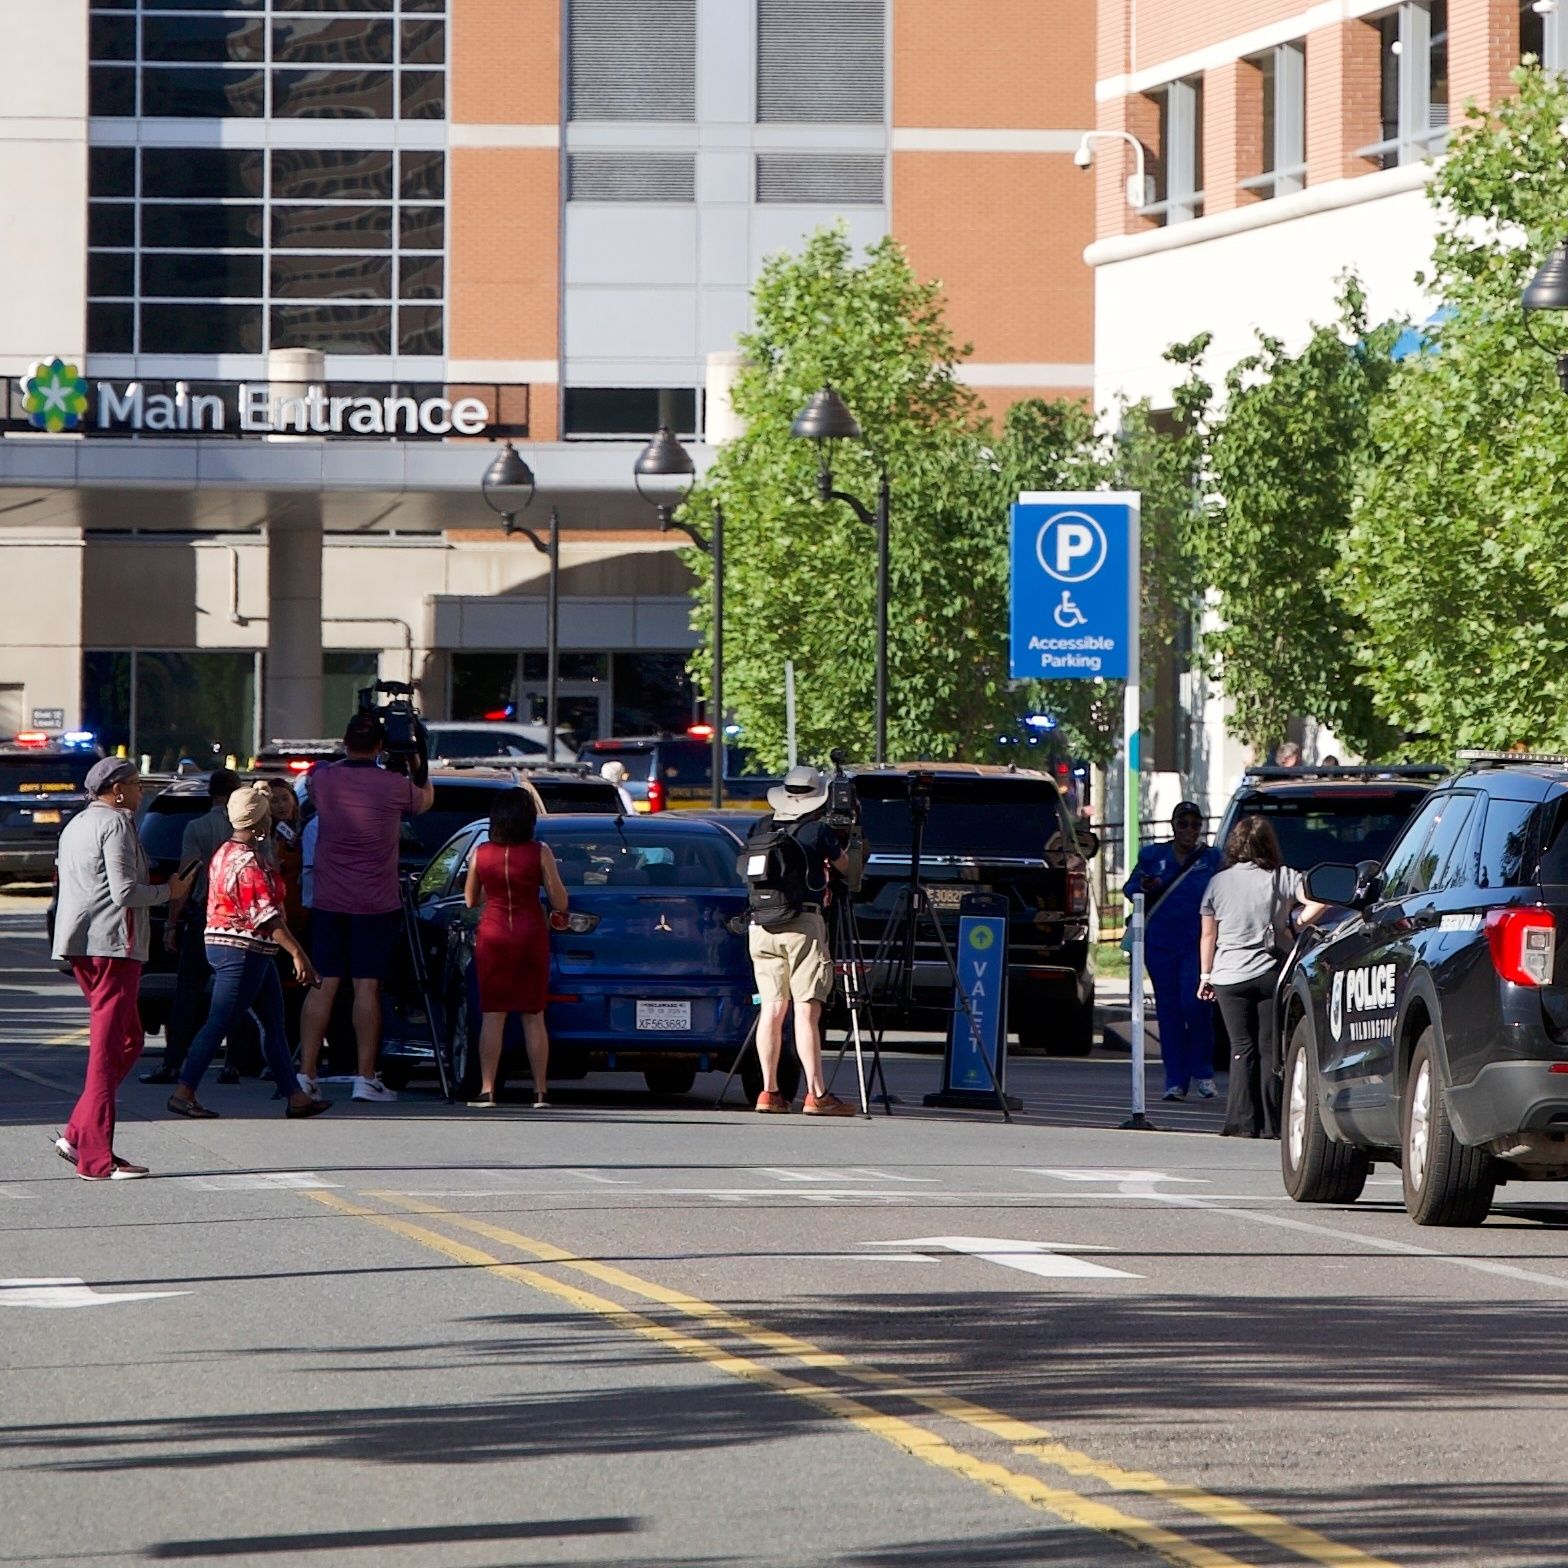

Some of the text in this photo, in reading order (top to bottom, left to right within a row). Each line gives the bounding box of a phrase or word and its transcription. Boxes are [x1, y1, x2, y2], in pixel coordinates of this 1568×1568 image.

[96, 381, 490, 435] Main Entrance
[1056, 523, 1094, 572] P
[1028, 635, 1115, 651] Accessible
[1041, 652, 1102, 671] Parking
[1346, 963, 1397, 1013] POLICE
